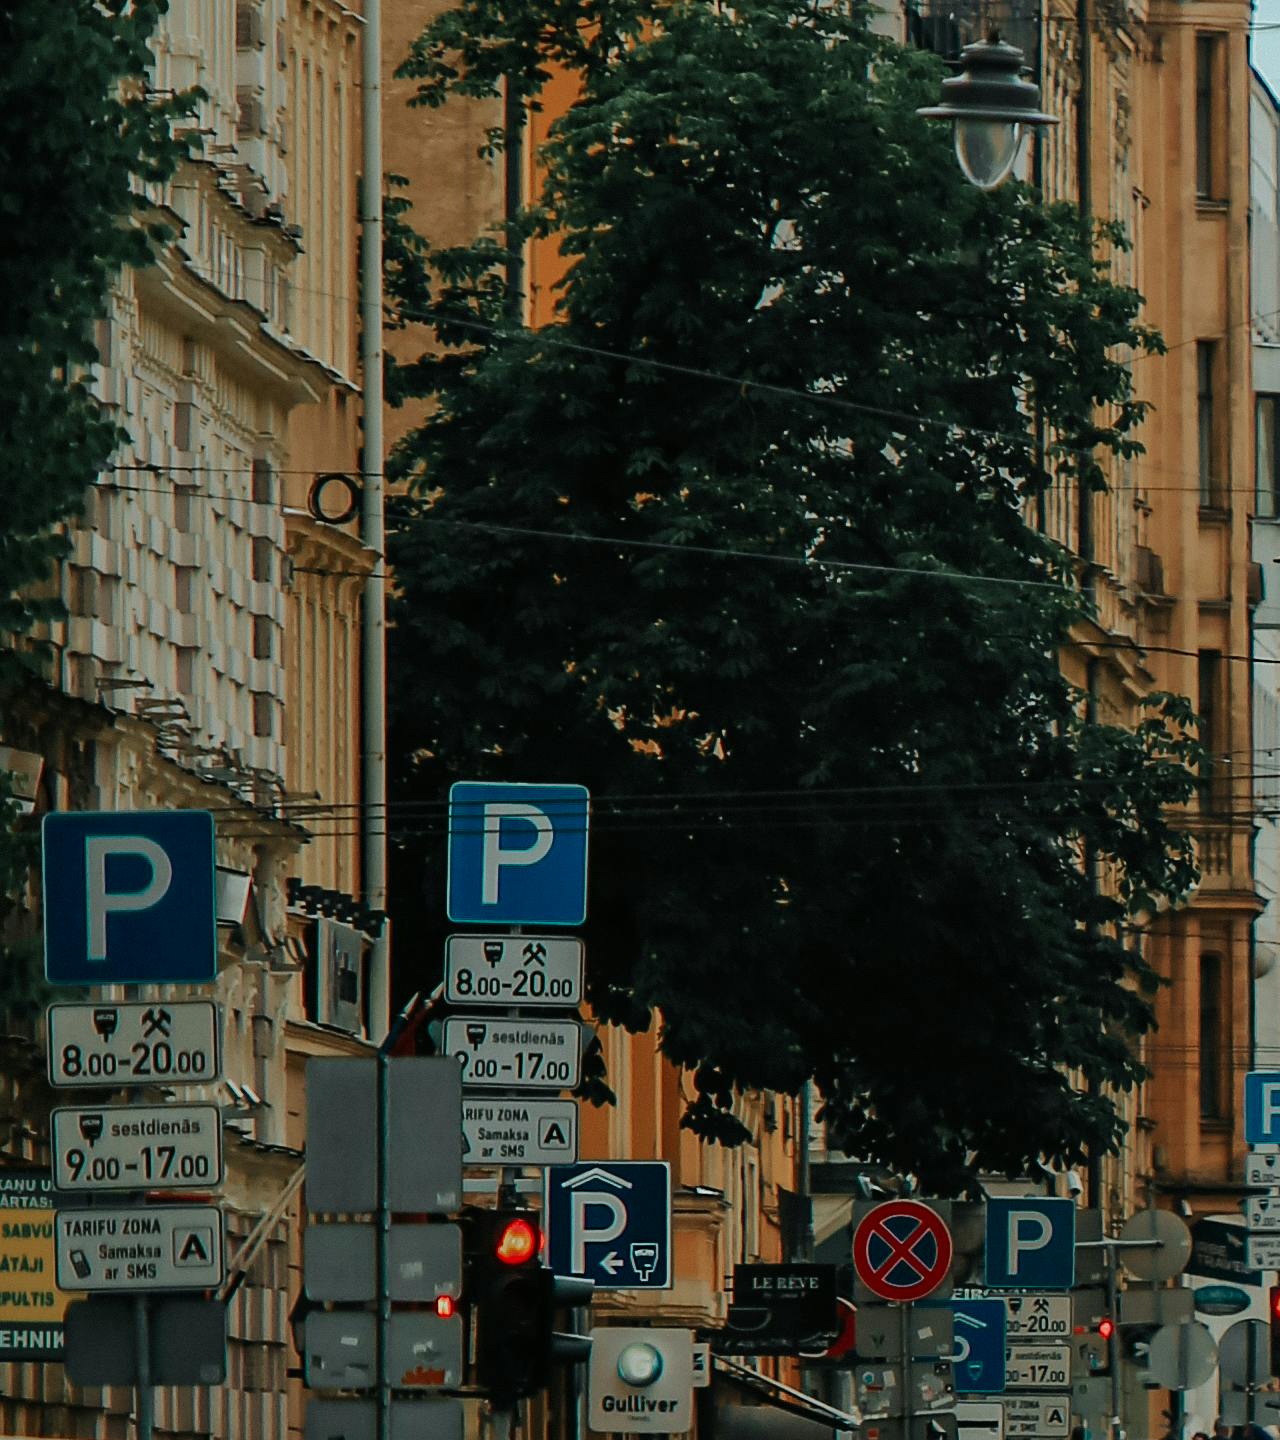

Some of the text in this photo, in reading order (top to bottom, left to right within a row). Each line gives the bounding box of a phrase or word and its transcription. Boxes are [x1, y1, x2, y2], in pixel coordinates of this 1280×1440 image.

[481, 803, 554, 906] P
[86, 835, 173, 962] P
[456, 968, 573, 998] 8.00-20.00
[492, 1031, 565, 1046] sestdienās
[62, 1042, 206, 1077] 8.00-20.00
[462, 1108, 530, 1122] RIFU ZONA
[111, 1118, 201, 1137] sestdienās
[478, 1128, 530, 1142] Samaksa
[544, 1123, 566, 1145] A
[481, 1146, 525, 1158] ar SMS
[64, 1218, 162, 1237] TARIFU ZONA
[571, 1191, 628, 1274] P
[98, 1244, 162, 1261] Samaksa
[179, 1233, 208, 1261] A
[1008, 1210, 1053, 1276] P
[105, 1263, 157, 1281] ar SMS
[753, 1276, 773, 1290] LE
[602, 1395, 678, 1413] Gulliver
[1047, 1408, 1063, 1424] A
